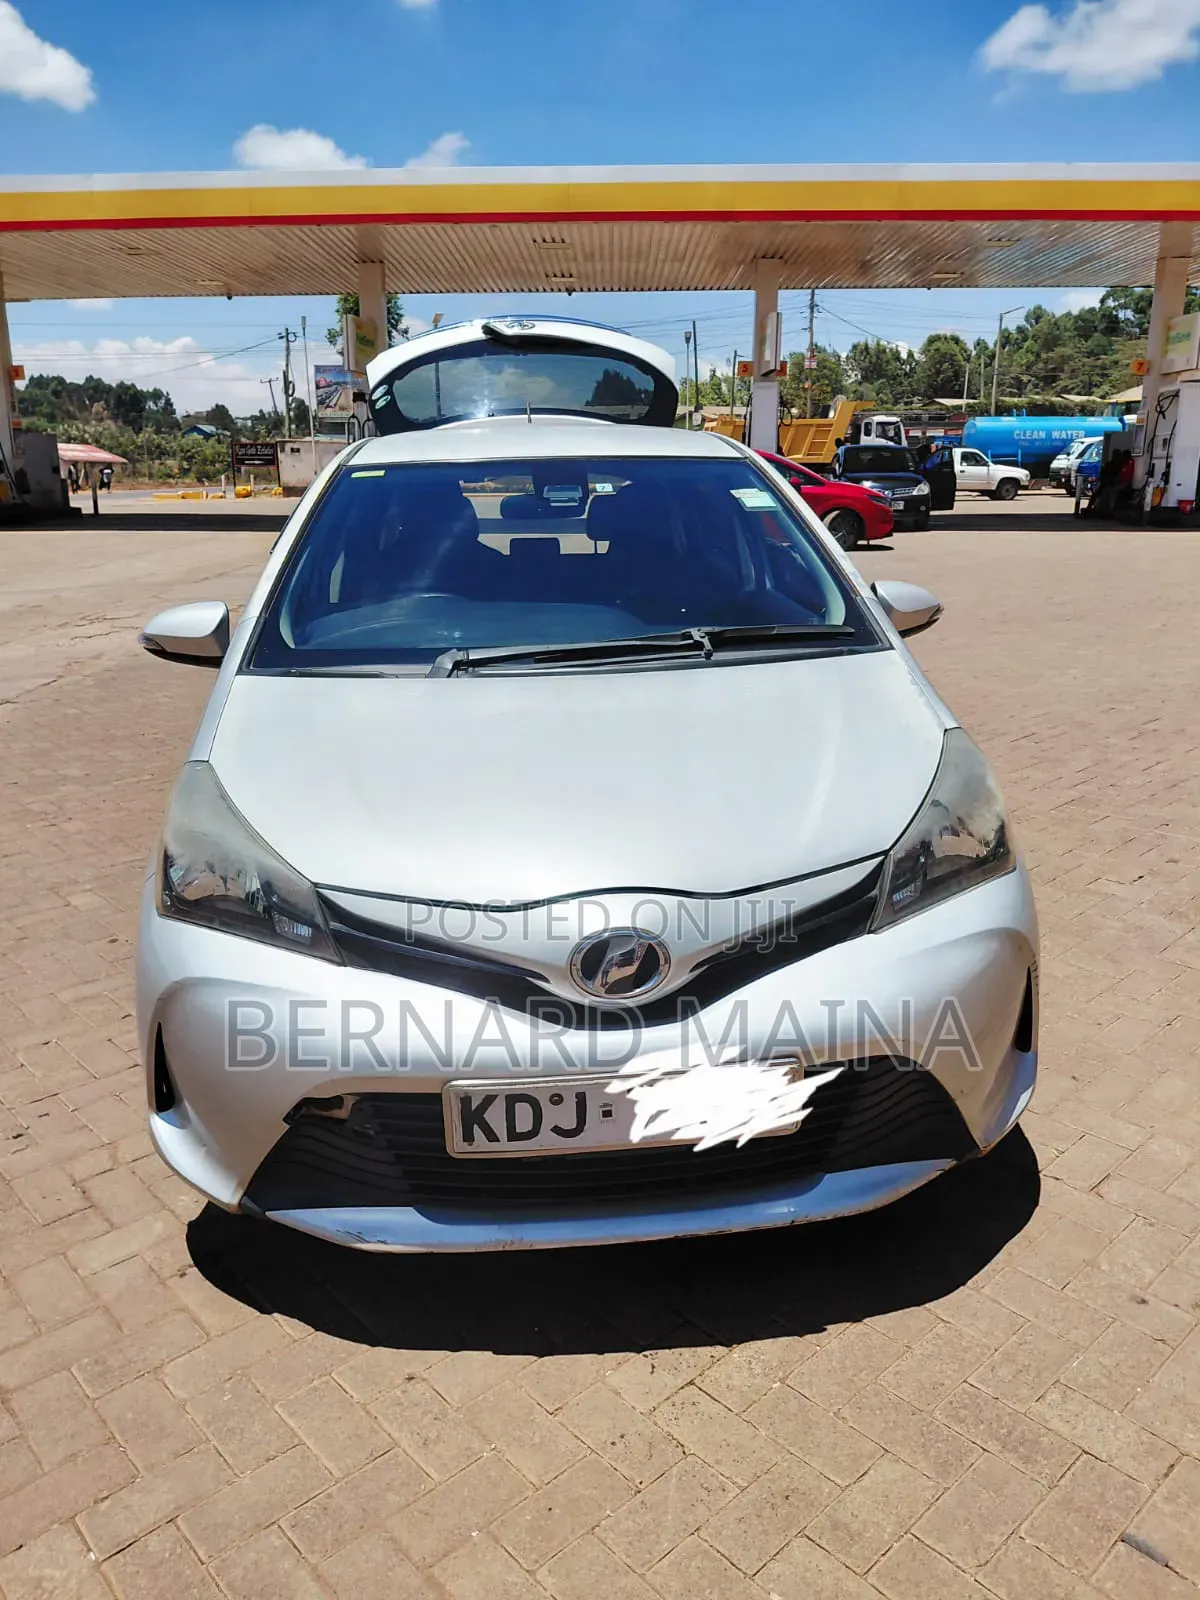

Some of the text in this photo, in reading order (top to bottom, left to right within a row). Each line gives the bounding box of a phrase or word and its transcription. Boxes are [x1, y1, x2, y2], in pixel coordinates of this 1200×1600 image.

[1013, 429, 1086, 440] CLEAN WATER
[459, 1091, 588, 1143] KDJ
